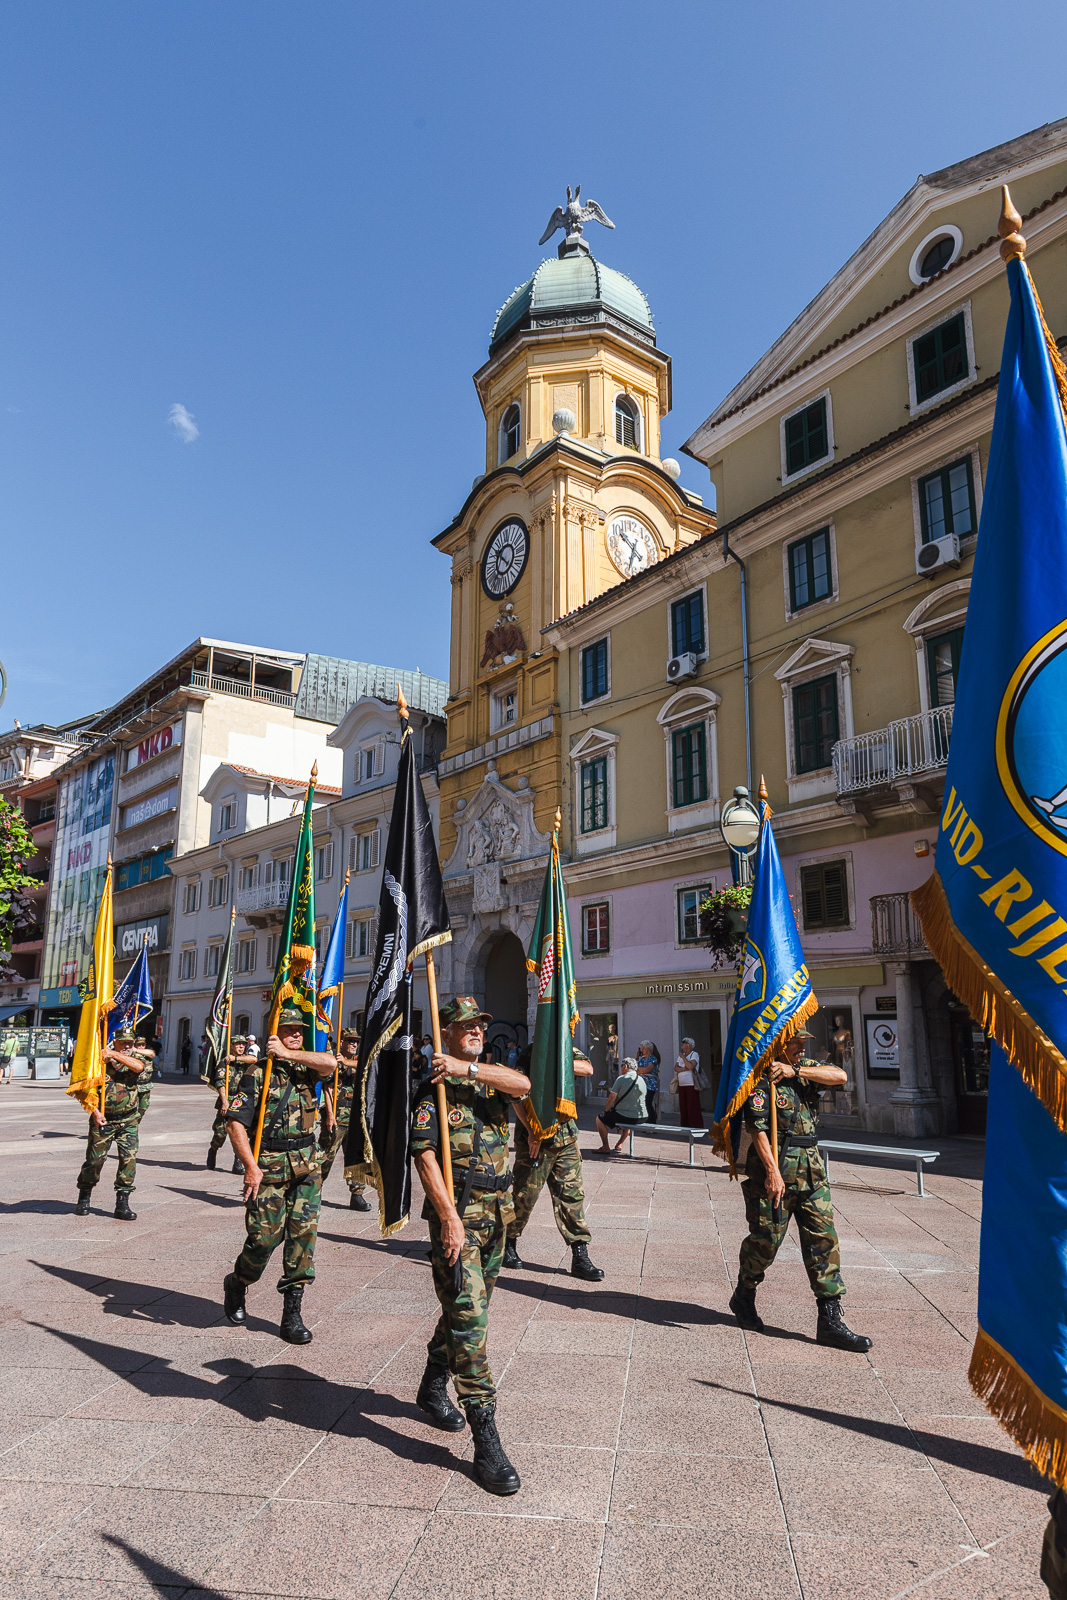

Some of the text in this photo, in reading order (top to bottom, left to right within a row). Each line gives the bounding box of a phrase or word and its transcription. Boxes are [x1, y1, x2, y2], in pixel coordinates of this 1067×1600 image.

[138, 726, 173, 764] NKD
[130, 797, 169, 825] naš dom
[67, 840, 93, 871] NKD
[942, 785, 1067, 996] VID-RIJE
[121, 925, 159, 952] CENTRA
[371, 933, 395, 992] SPREMNI
[58, 989, 73, 1005] TEDi
[645, 981, 710, 995] intimissimi
